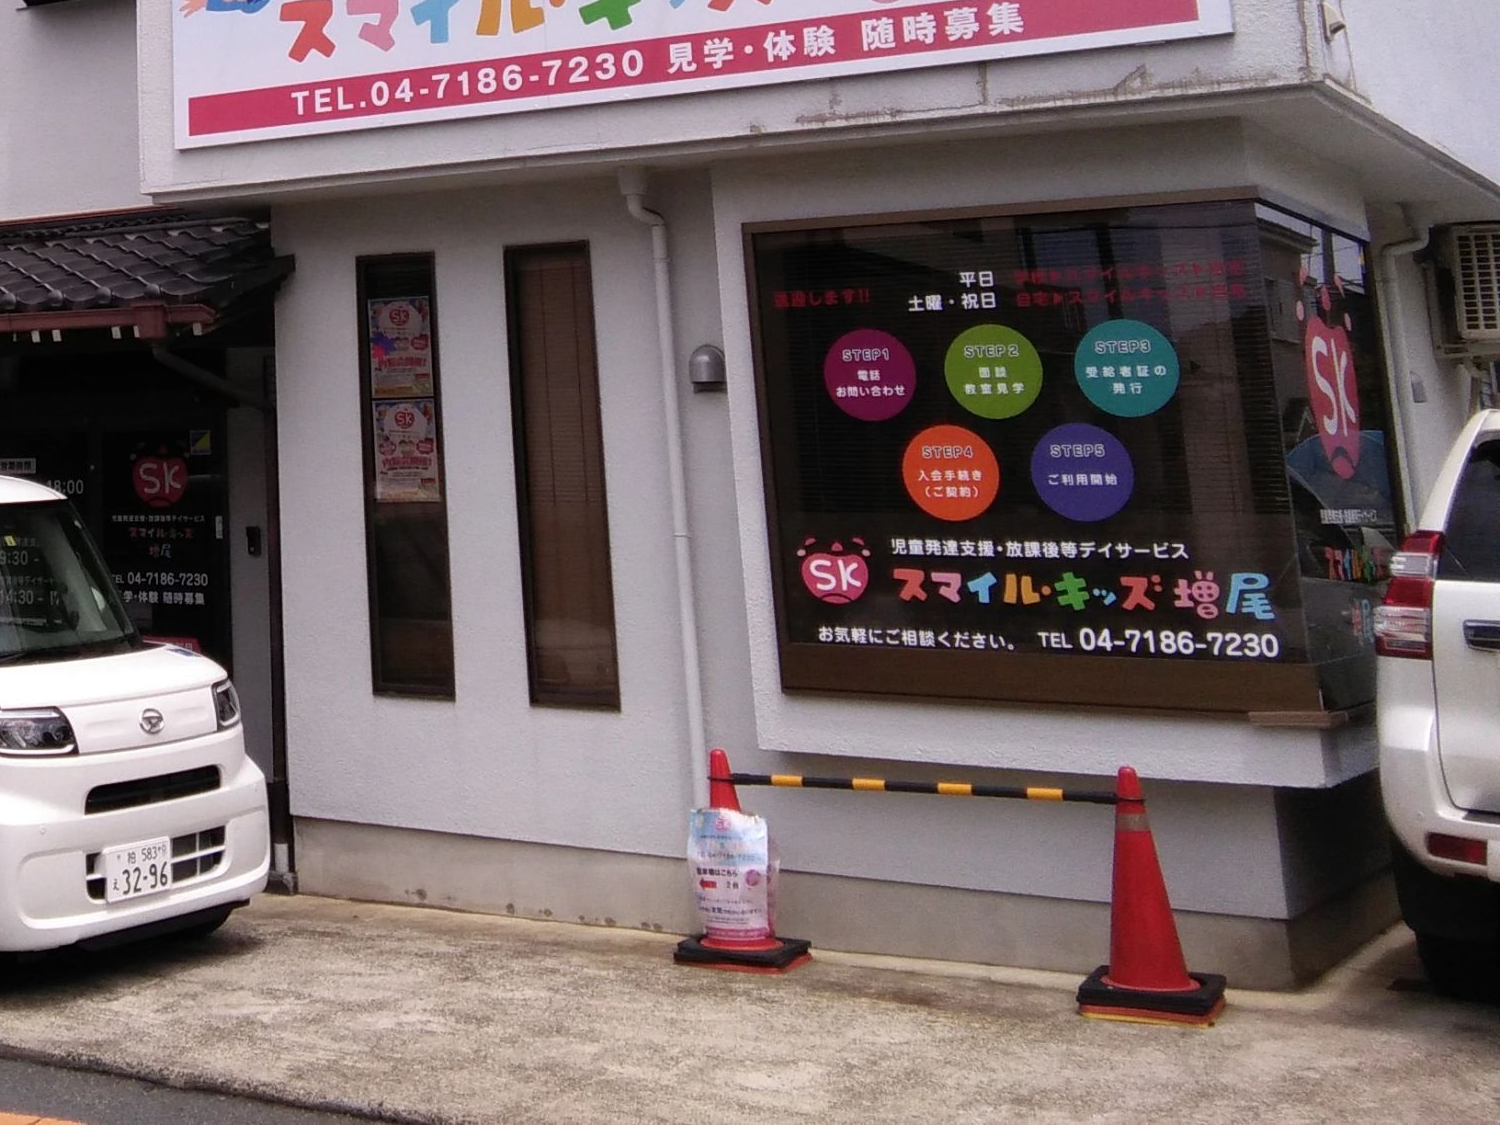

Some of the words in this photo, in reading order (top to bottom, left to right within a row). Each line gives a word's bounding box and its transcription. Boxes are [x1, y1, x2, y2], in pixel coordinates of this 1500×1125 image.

[667, 24, 836, 74] 見学・体験
[861, 2, 1025, 51] 随時募集
[959, 270, 995, 288] 平日
[908, 292, 997, 312] 土曜・祝日
[842, 348, 890, 362] STEP1
[1095, 339, 1152, 354] STEP3
[836, 384, 906, 398] お問い合わせ
[1311, 336, 1357, 437] SK
[922, 445, 974, 459] STEP4
[1050, 443, 1105, 458] STEP5
[138, 461, 182, 494] SK
[918, 469, 983, 482] 入会手続き
[1048, 472, 1118, 486] ご利用開始
[890, 537, 1190, 561] 児童発達支援・放課後等デイサービス
[127, 572, 209, 587] 04-7186-7230
[809, 558, 864, 591] SK
[818, 626, 1015, 652] お気軽にご相談ください。
[1037, 632, 1073, 649] TEL
[1079, 627, 1280, 659] 04-7186-7230
[122, 861, 169, 896] 32-96
